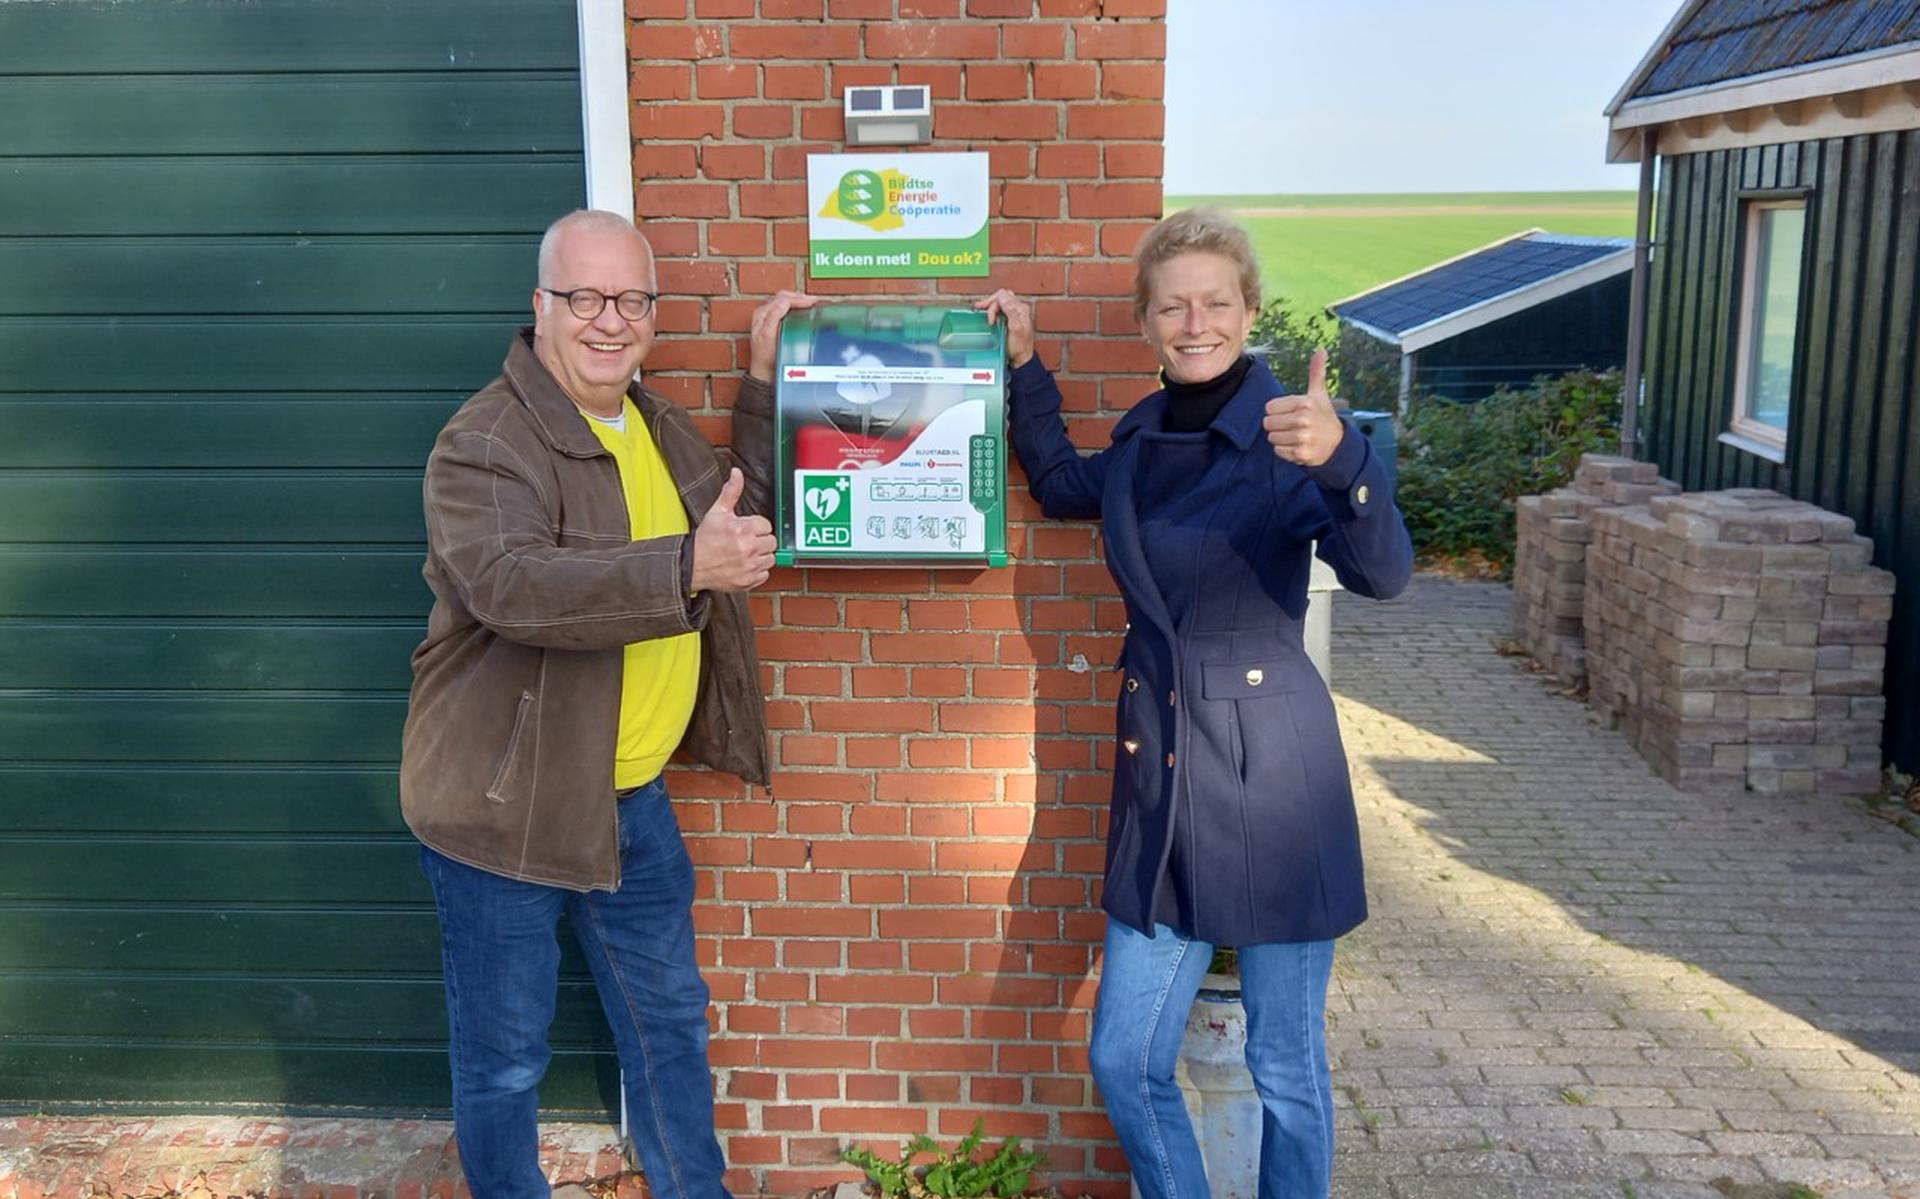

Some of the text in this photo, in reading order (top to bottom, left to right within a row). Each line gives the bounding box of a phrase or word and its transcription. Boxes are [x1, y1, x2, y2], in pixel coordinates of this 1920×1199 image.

[888, 179, 934, 190] Bildtse
[889, 191, 938, 203] Energie
[889, 204, 961, 218] Coöperatie
[815, 252, 982, 266] Ik doen met! Dou ok?
[806, 527, 850, 544] AED
